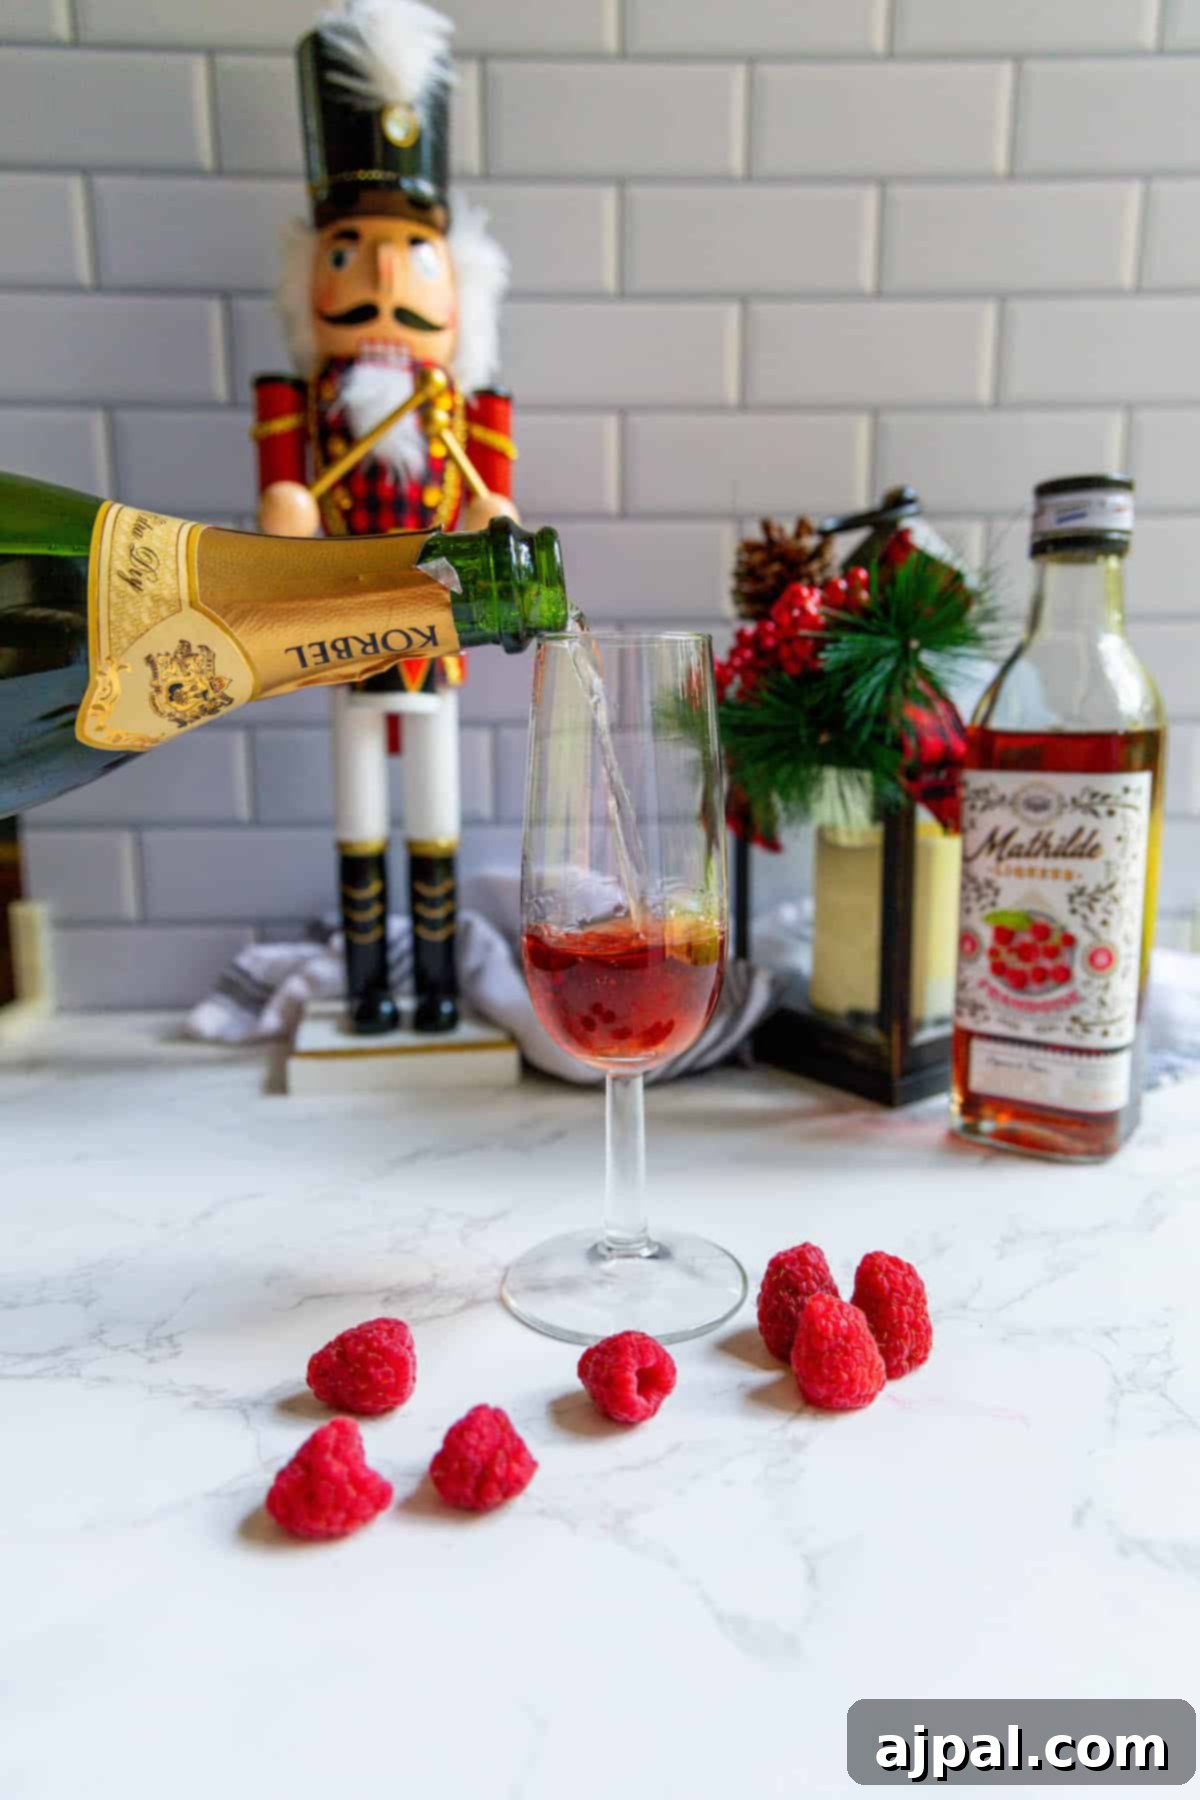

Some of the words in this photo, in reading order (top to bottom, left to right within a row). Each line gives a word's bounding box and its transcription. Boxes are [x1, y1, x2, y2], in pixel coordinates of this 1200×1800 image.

[117, 544, 160, 594] Dry
[285, 624, 439, 668] KORBEL
[962, 825, 1104, 863] Mathilde
